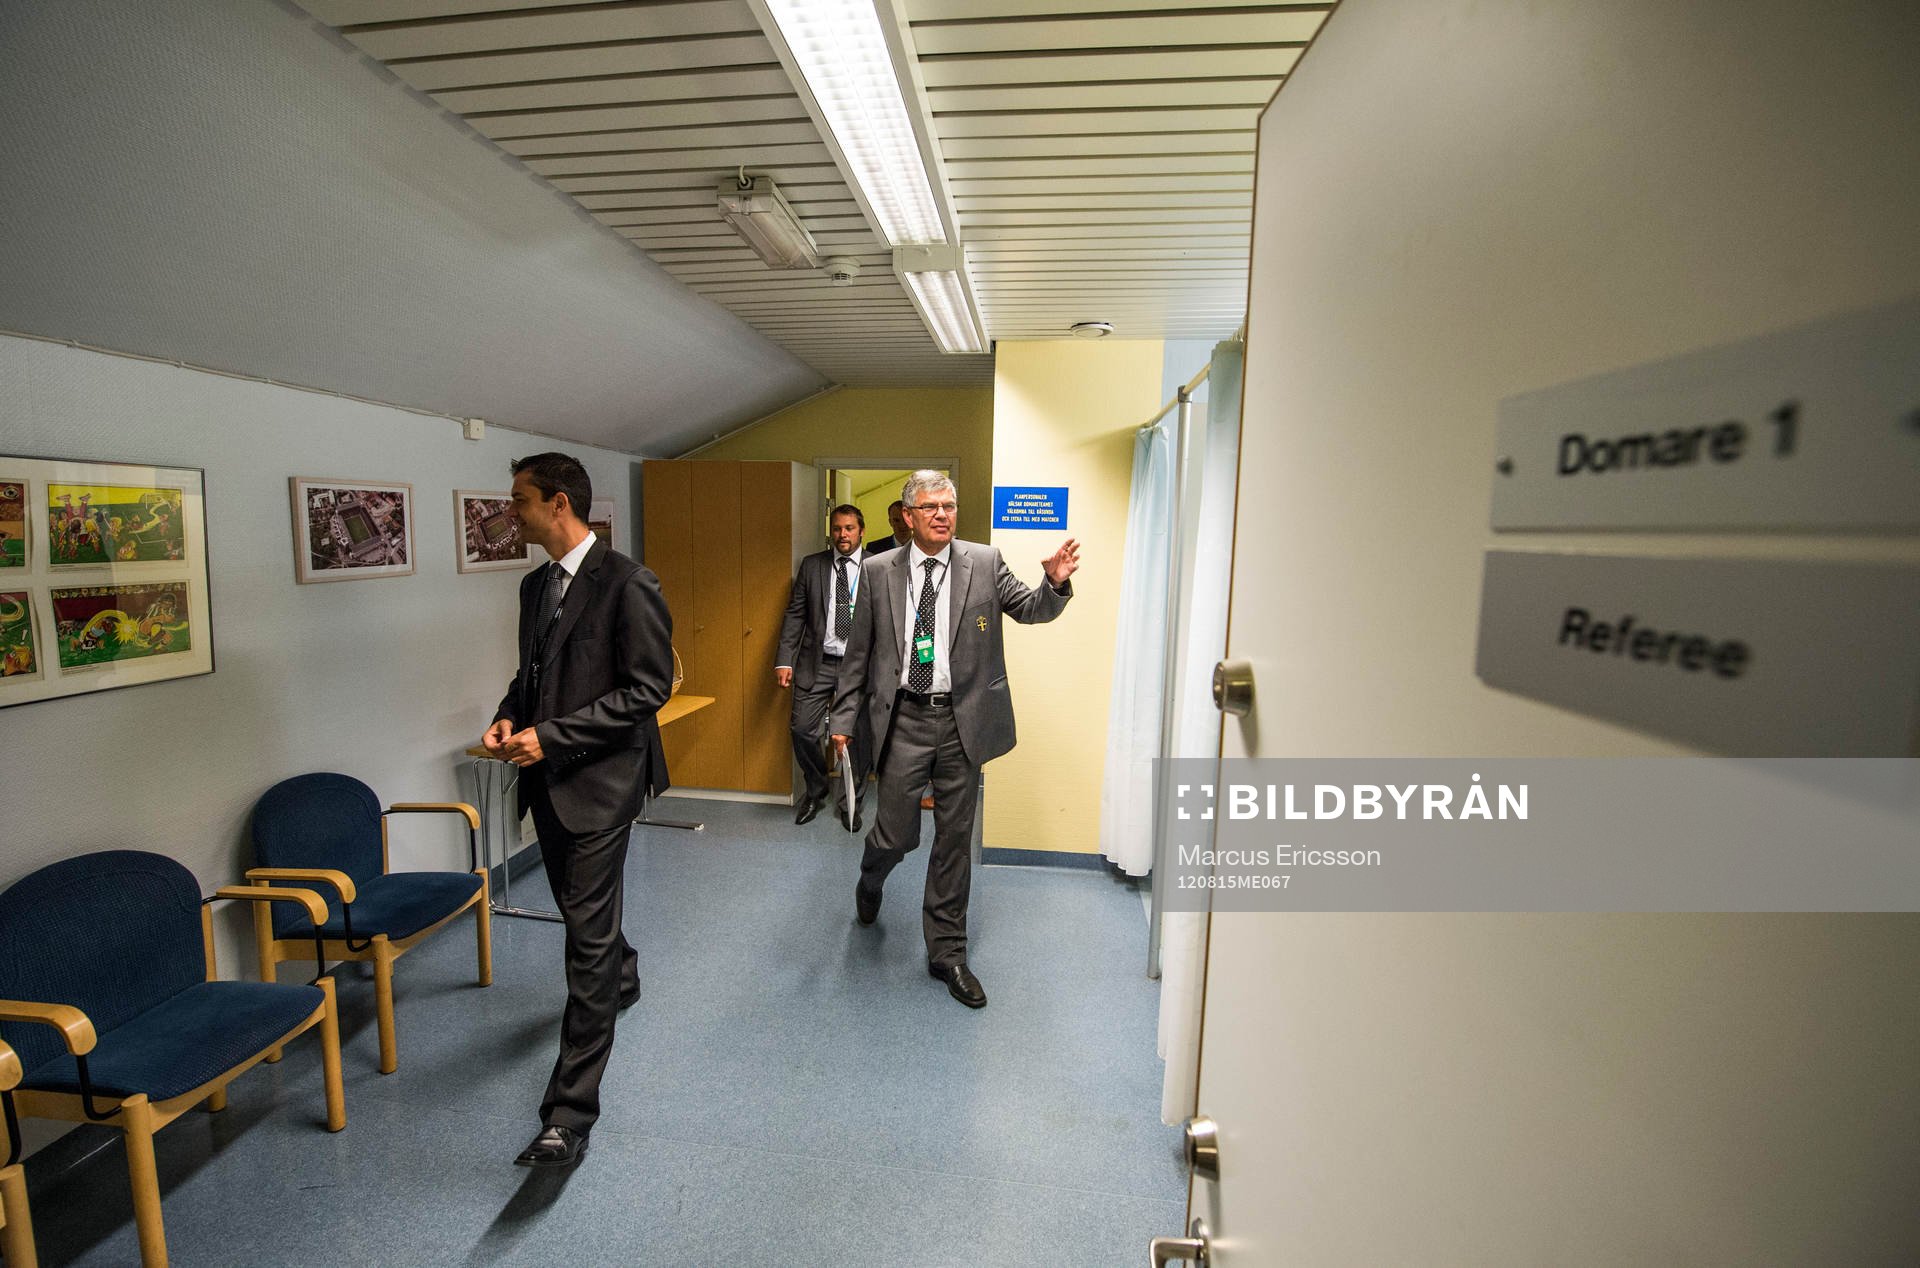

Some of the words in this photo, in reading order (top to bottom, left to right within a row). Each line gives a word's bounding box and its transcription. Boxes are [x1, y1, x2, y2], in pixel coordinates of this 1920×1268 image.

[1558, 418, 1748, 477] Domare
[1768, 399, 1802, 458] 1
[1558, 607, 1752, 679] Referee
